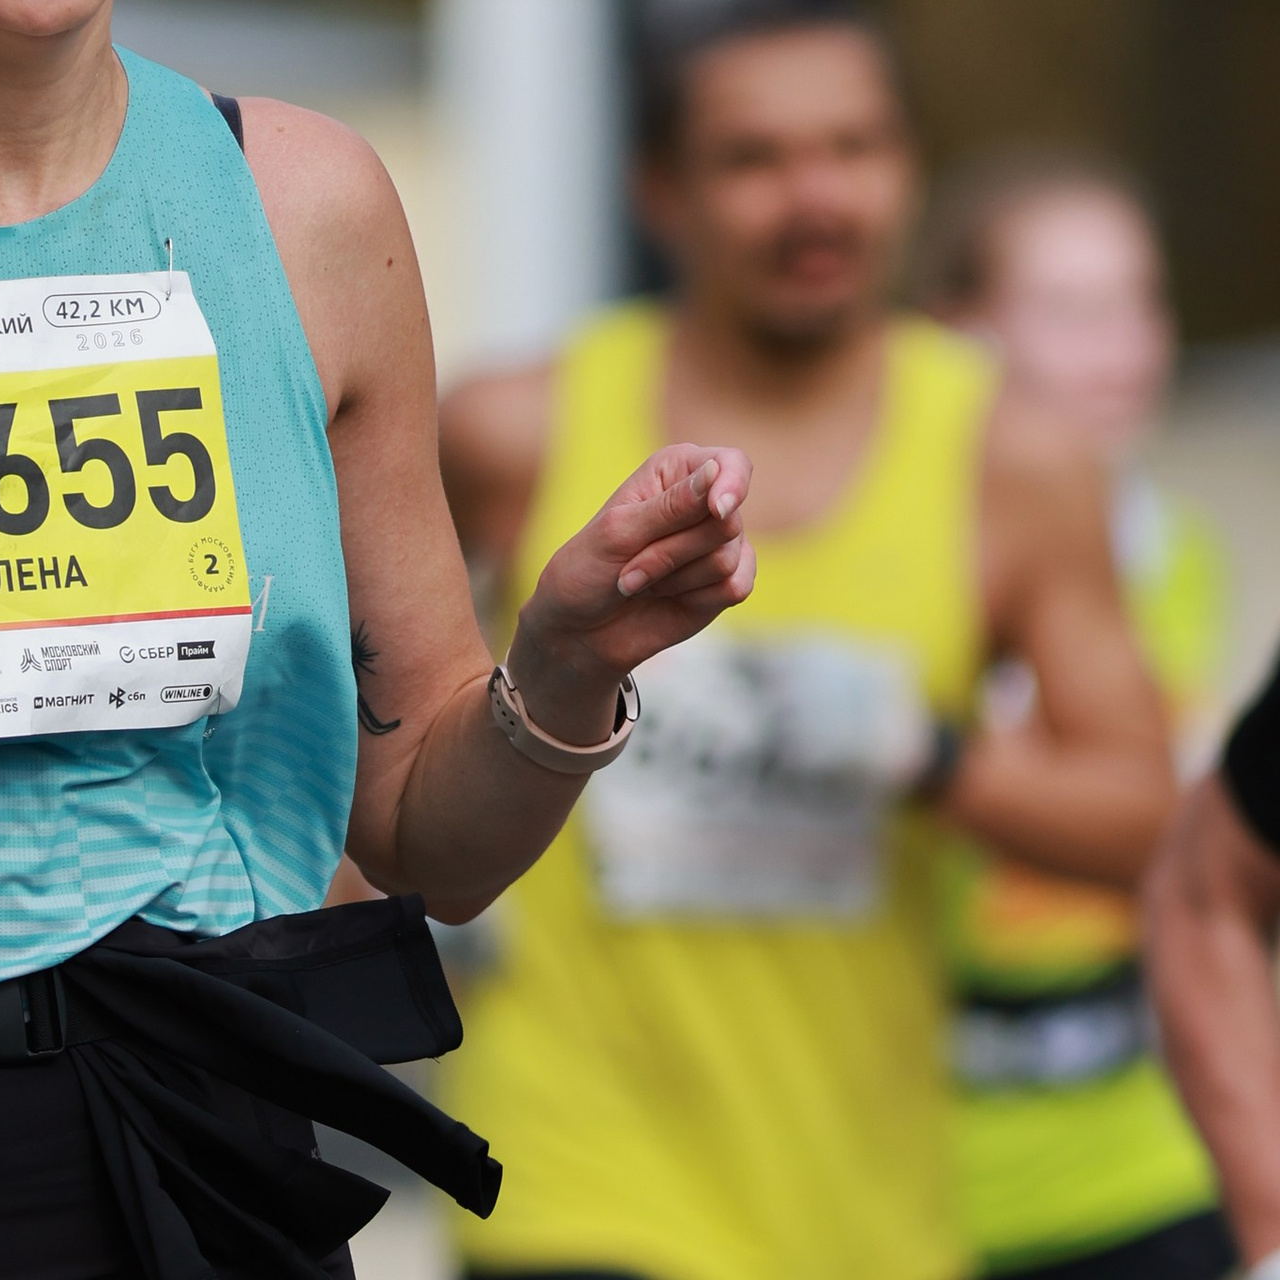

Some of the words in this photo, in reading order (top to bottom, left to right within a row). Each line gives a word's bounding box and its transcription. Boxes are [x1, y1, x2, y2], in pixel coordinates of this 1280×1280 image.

[56, 300, 101, 321] 42,2
[76, 328, 143, 351] 2026
[201, 537, 235, 585] МОСКОВСКИЙ
[204, 554, 219, 575] 2
[40, 641, 101, 658] МОСКОВСКИЙ
[138, 647, 174, 660] СБЕР
[181, 645, 209, 657] Прайм
[44, 658, 72, 672] СПОРТ
[164, 687, 202, 700] WINLINE
